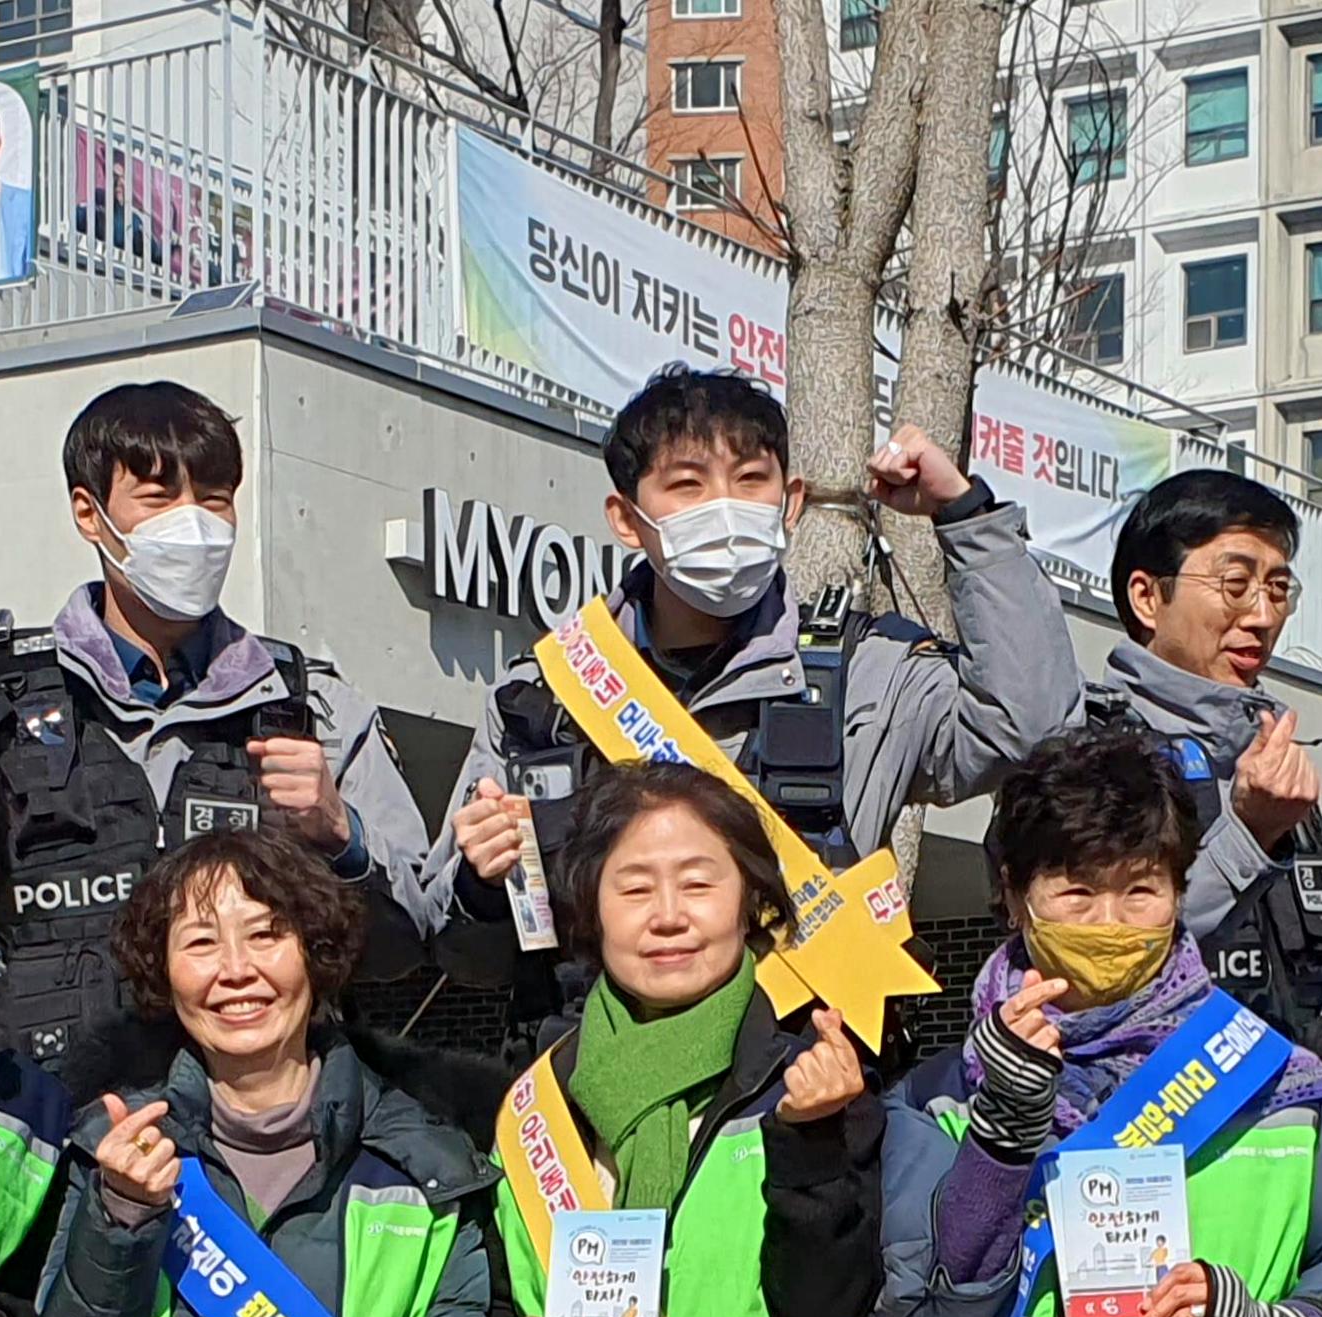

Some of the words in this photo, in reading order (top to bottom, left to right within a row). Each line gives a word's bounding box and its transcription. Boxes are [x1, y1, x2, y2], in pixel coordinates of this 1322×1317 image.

[528, 216, 620, 315] 당신이
[631, 268, 719, 358] 지키는
[972, 412, 1025, 475] 켜줄
[423, 487, 646, 632] MYON
[13, 873, 133, 914] POLICE
[1210, 949, 1263, 979] ICE
[1088, 1178, 1112, 1198] PM
[1088, 1210, 1160, 1228] 안전하게
[577, 1238, 599, 1257] PM
[572, 1269, 636, 1287] 안전하게
